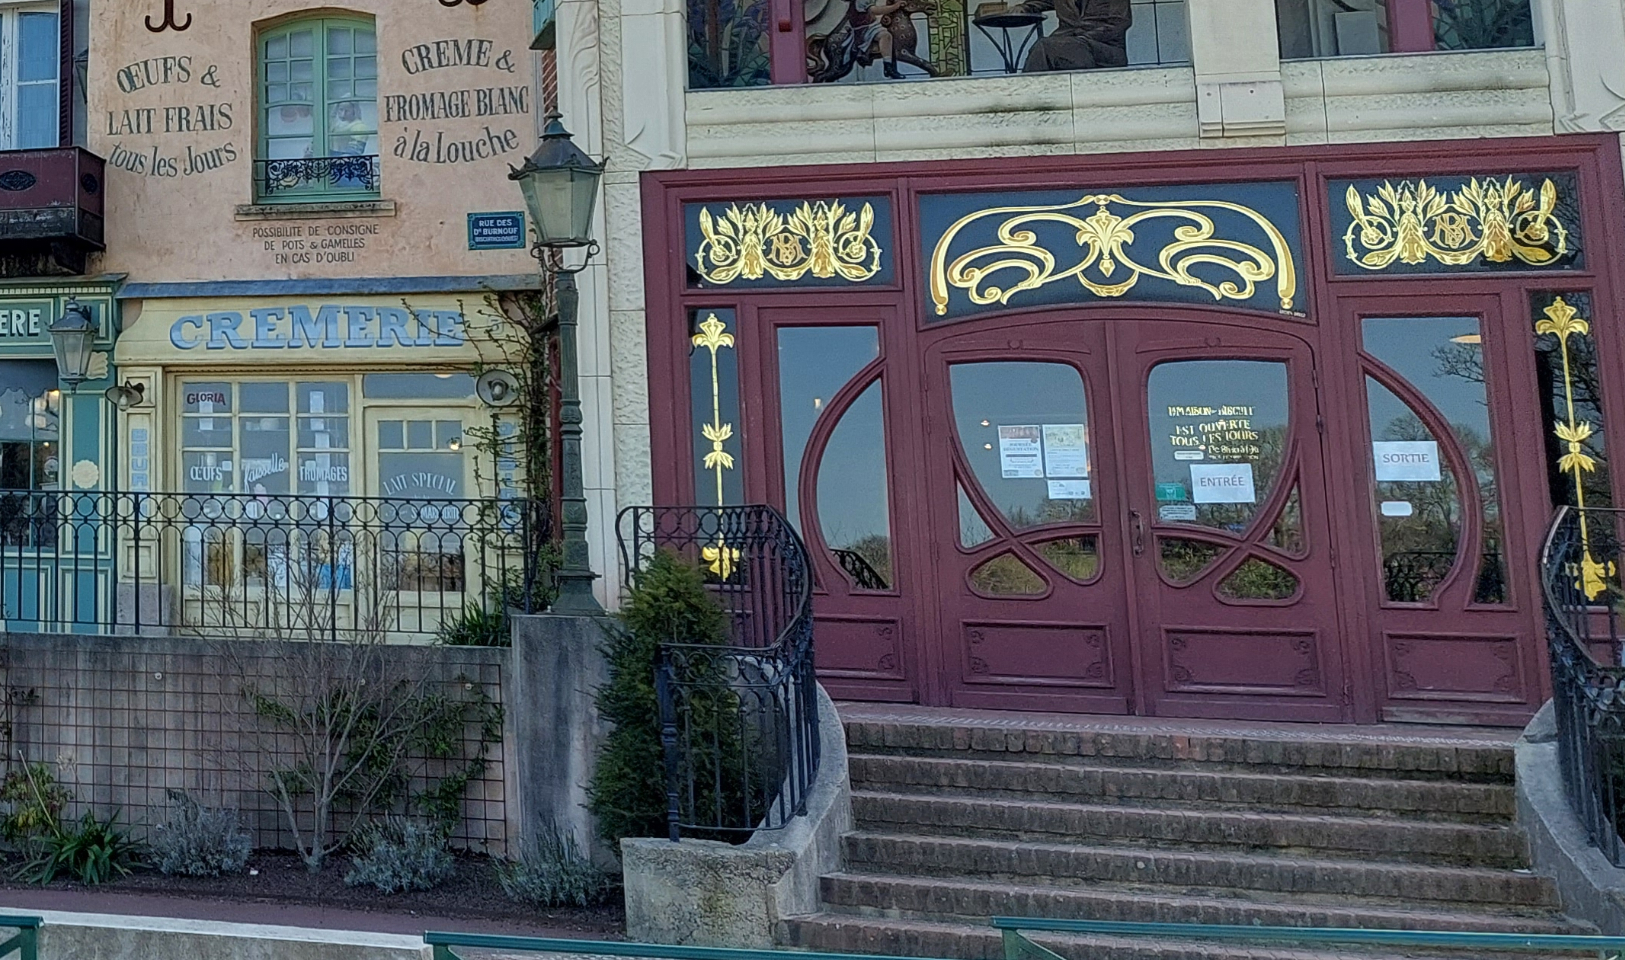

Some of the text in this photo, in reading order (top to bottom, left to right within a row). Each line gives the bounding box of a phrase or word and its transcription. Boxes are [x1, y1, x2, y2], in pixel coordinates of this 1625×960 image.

[402, 39, 515, 74] CREME &
[117, 55, 220, 93] ŒUFS &
[384, 86, 529, 122] FROMAGE BLANC
[107, 102, 233, 135] LAIT FRAIS
[394, 126, 519, 163] à la Louche
[109, 141, 237, 177] tous les Jours
[496, 219, 512, 227] DES
[253, 224, 379, 238] POSSIBILITE DE CONSIGNE
[483, 227, 518, 235] BURNOUF
[264, 241, 275, 250] DE
[282, 240, 305, 250] POTS
[321, 238, 365, 249] GAMELLES
[275, 251, 355, 264] EN CAS D'OUBLI
[170, 305, 465, 350] CREMERIE
[186, 393, 225, 406] GLORIA
[1169, 435, 1200, 446] TOUS
[1383, 453, 1429, 463] SORTIE
[299, 466, 348, 482] FROMAGES
[1200, 475, 1245, 487] ENTRÉE
[383, 473, 456, 495] LAIT SPECIAL
